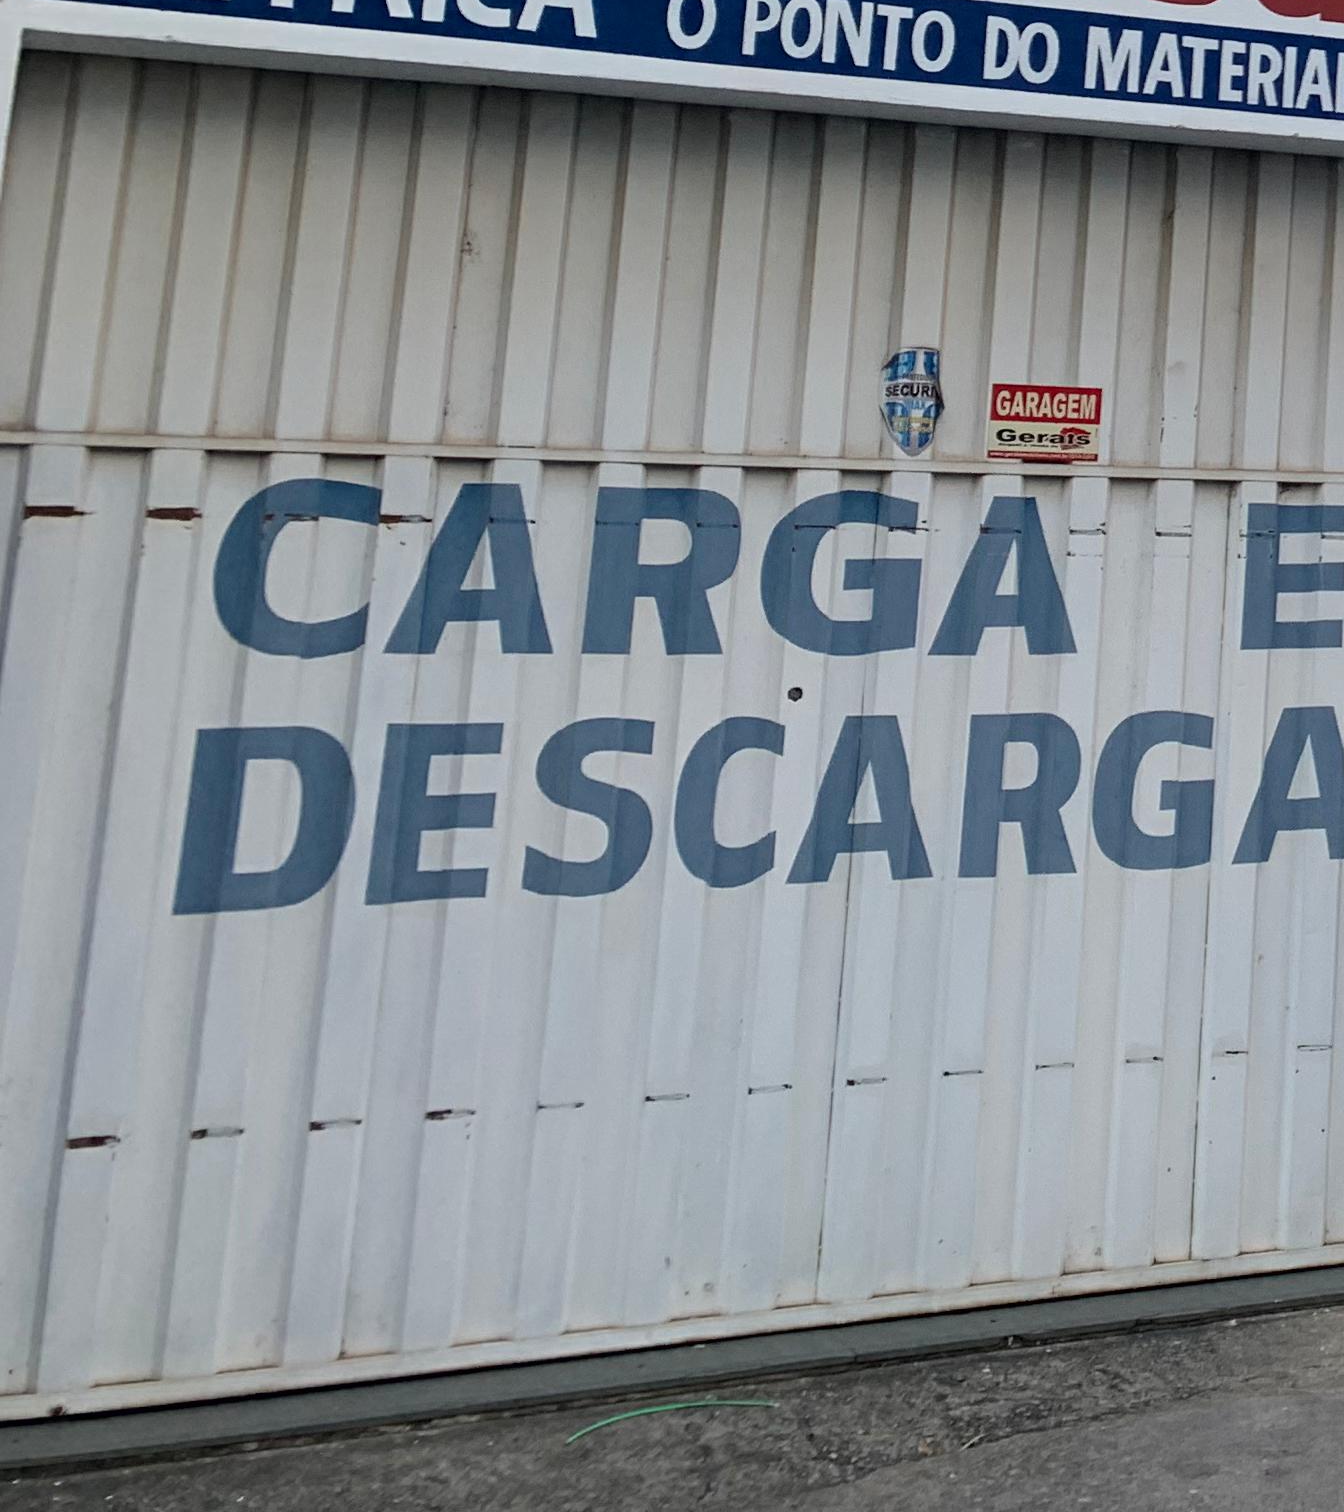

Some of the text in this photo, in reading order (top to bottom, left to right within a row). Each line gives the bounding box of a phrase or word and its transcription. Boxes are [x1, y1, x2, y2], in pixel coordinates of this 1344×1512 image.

[983, 15, 1059, 85] DO
[996, 390, 1097, 420] GARAGEM
[996, 428, 1091, 445] Gerais
[212, 477, 1078, 659] CARGA
